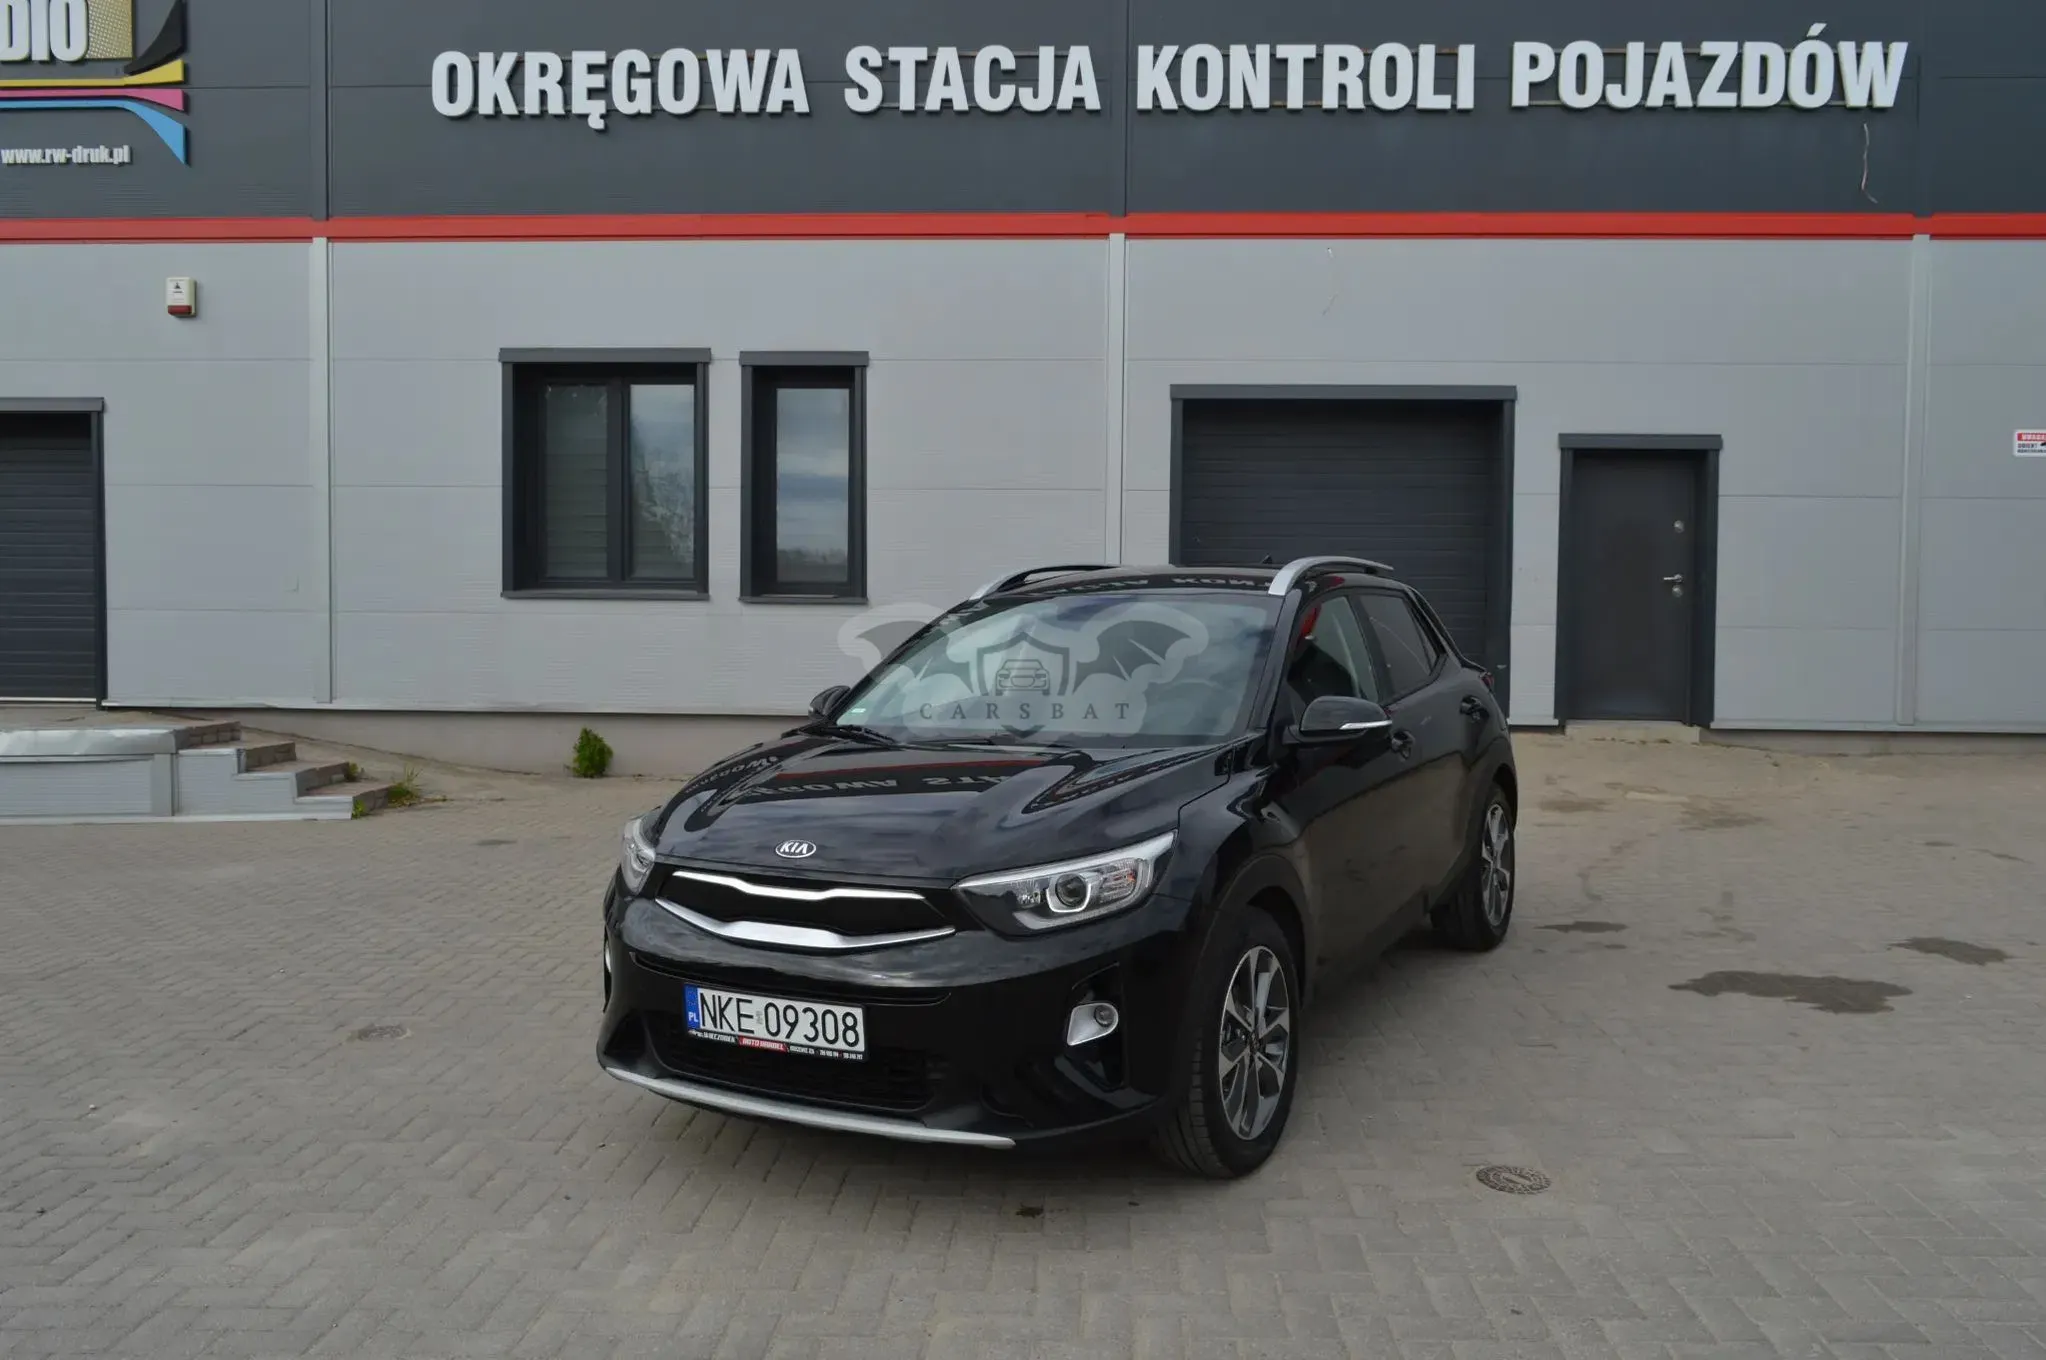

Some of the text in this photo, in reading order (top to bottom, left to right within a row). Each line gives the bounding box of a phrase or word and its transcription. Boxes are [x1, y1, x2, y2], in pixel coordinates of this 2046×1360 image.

[431, 22, 1909, 130] OKRĘGOWA STACJA KONTROLI POJAZDÓW
[1, 145, 130, 165] www.rw-druk.pl
[779, 841, 809, 855] KIA
[688, 1011, 699, 1023] PL
[700, 992, 860, 1048] NKE 09308
